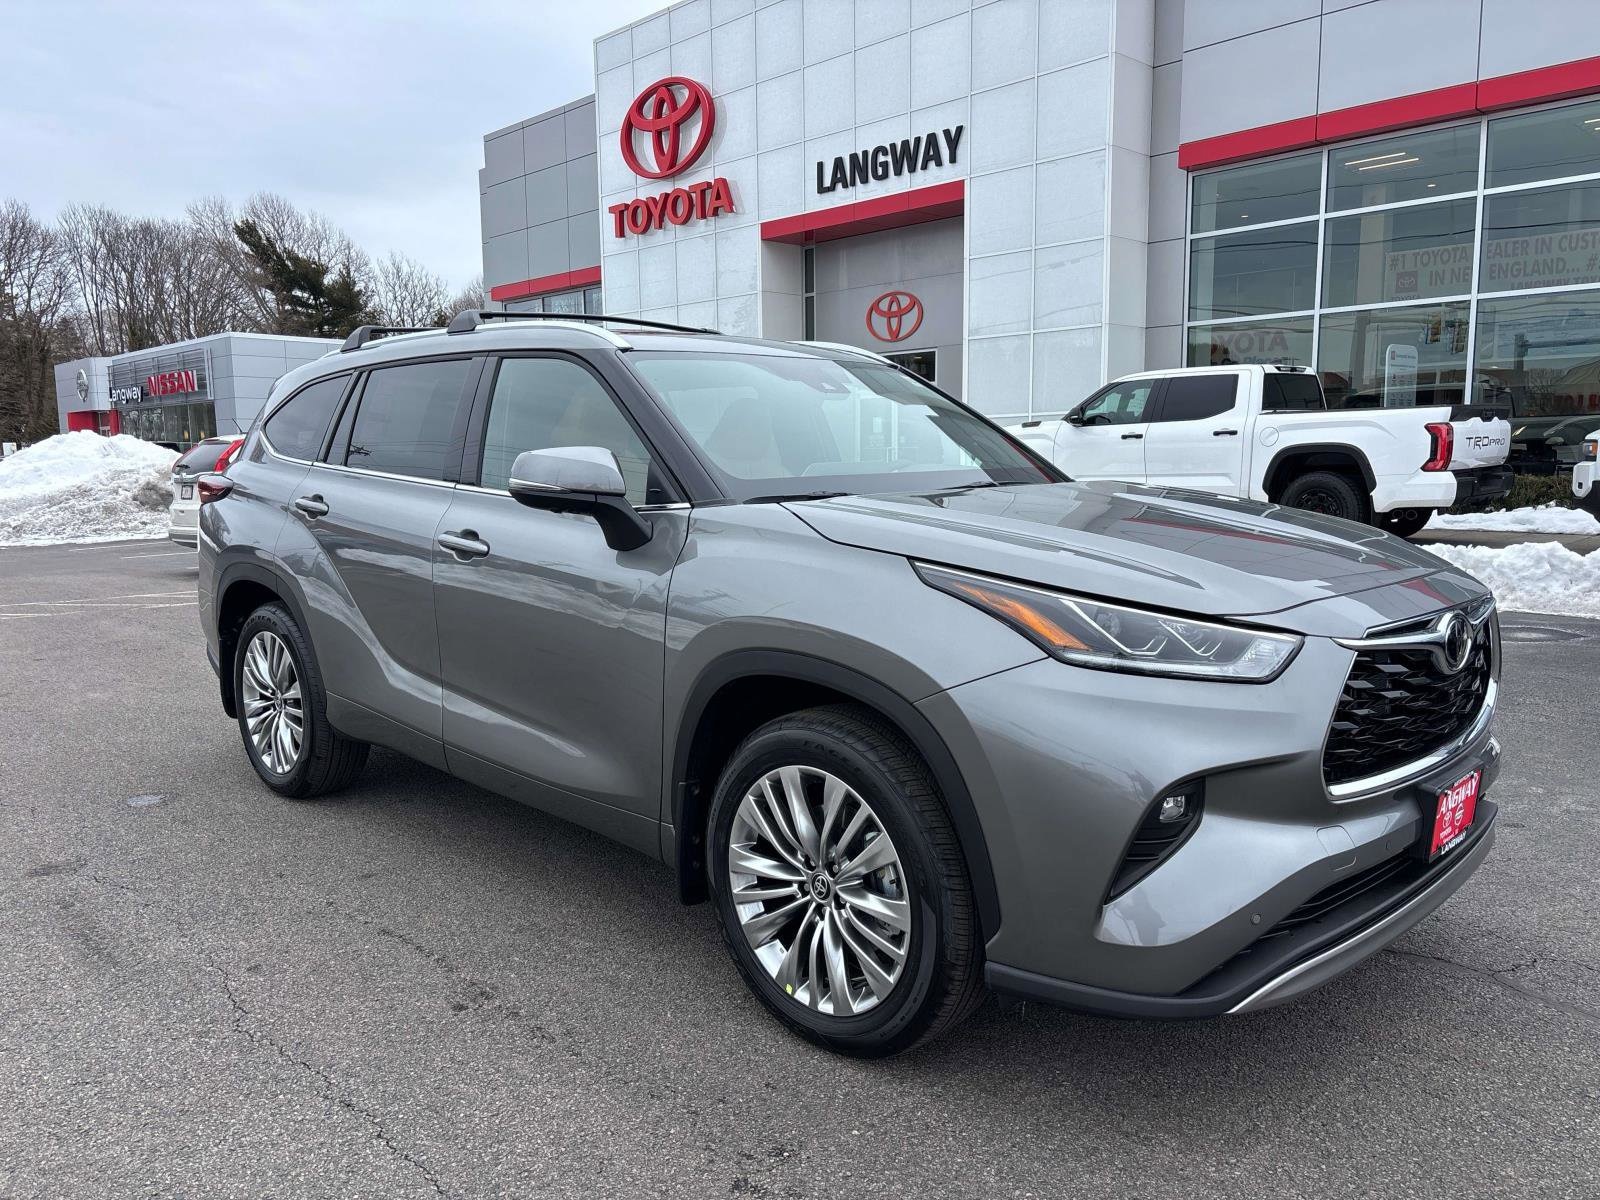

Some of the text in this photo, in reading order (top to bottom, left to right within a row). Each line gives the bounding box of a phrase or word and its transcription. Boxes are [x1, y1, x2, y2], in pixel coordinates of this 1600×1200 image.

[816, 125, 964, 194] LANGWAY
[608, 177, 736, 239] TOYOTA
[1412, 246, 1469, 268] TOYOTA
[1487, 239, 1530, 260] EALER
[1534, 235, 1553, 255] IN
[1429, 268, 1446, 287] IN
[1450, 265, 1470, 285] NE
[108, 369, 198, 404] Langway NISSAN
